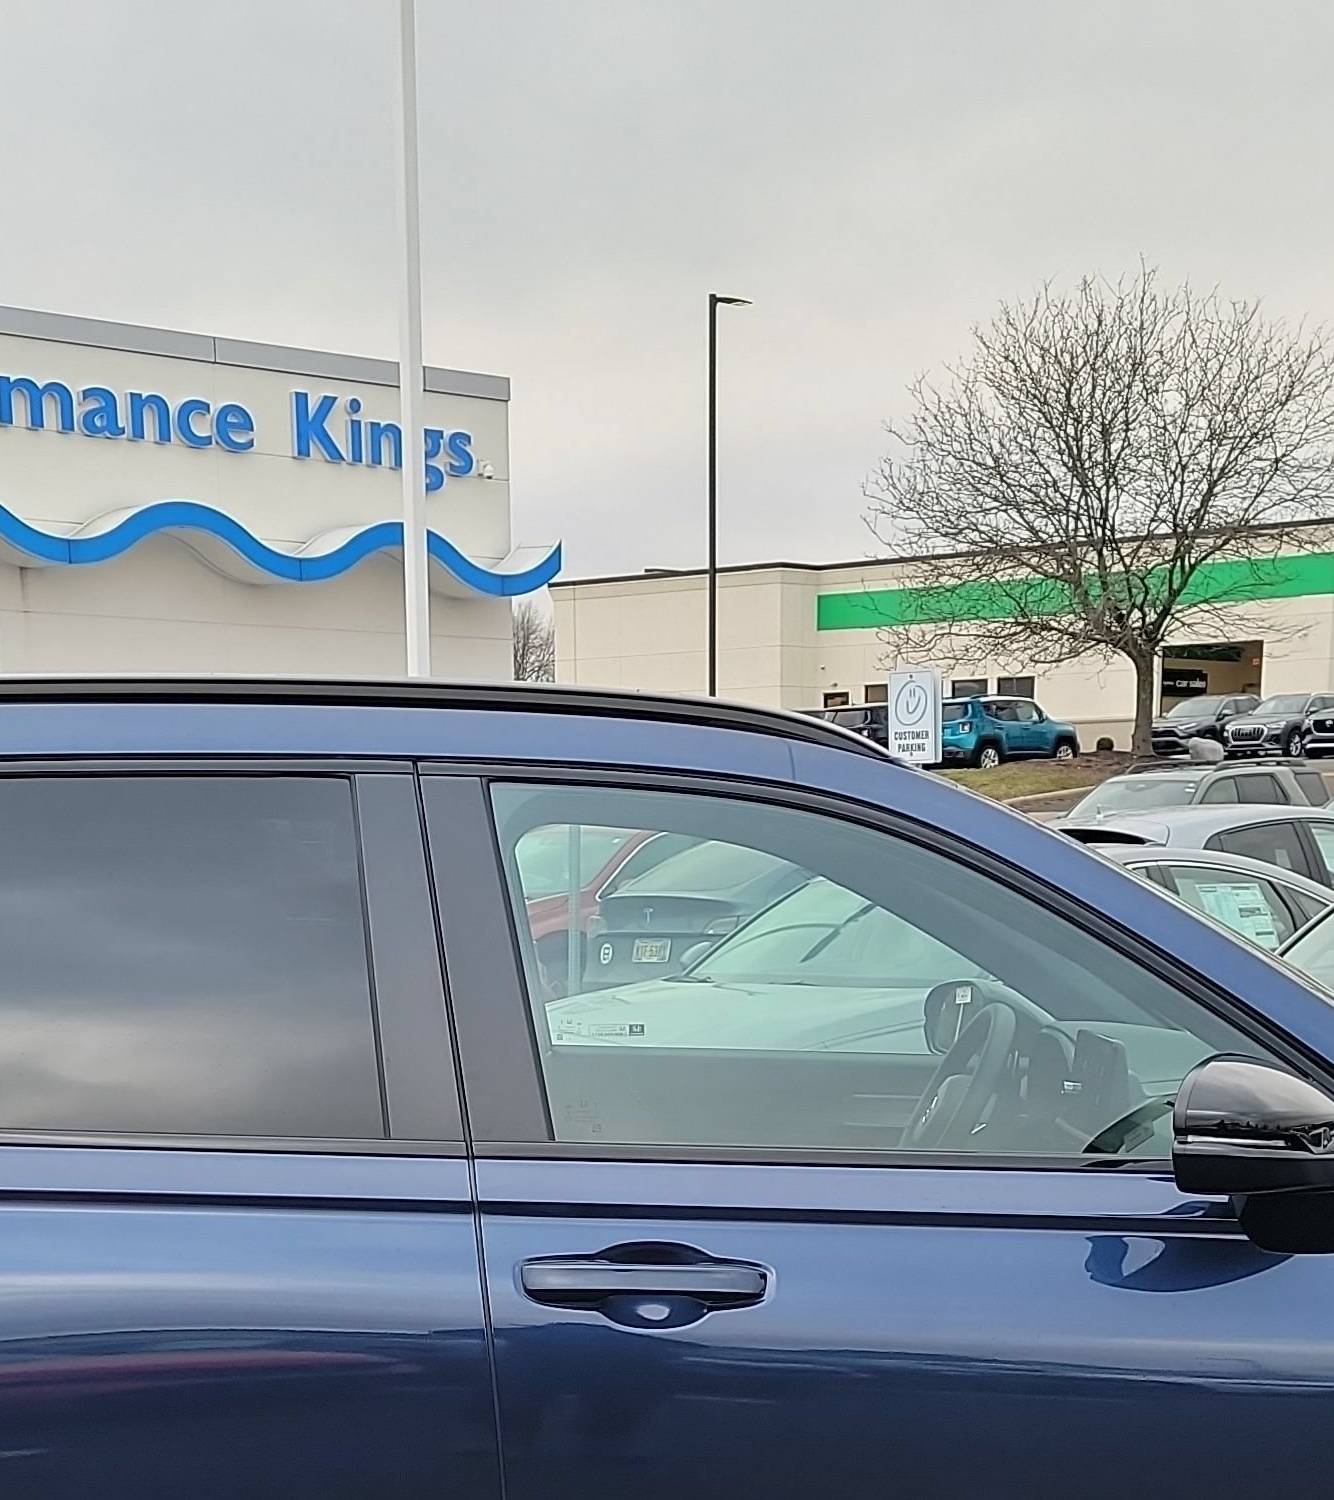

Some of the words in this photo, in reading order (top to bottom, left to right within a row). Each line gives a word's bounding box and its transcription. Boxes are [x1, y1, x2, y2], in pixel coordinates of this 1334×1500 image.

[289, 390, 475, 493] Kings
[894, 730, 929, 741] CUSTOMER
[897, 743, 926, 753] PARKING
